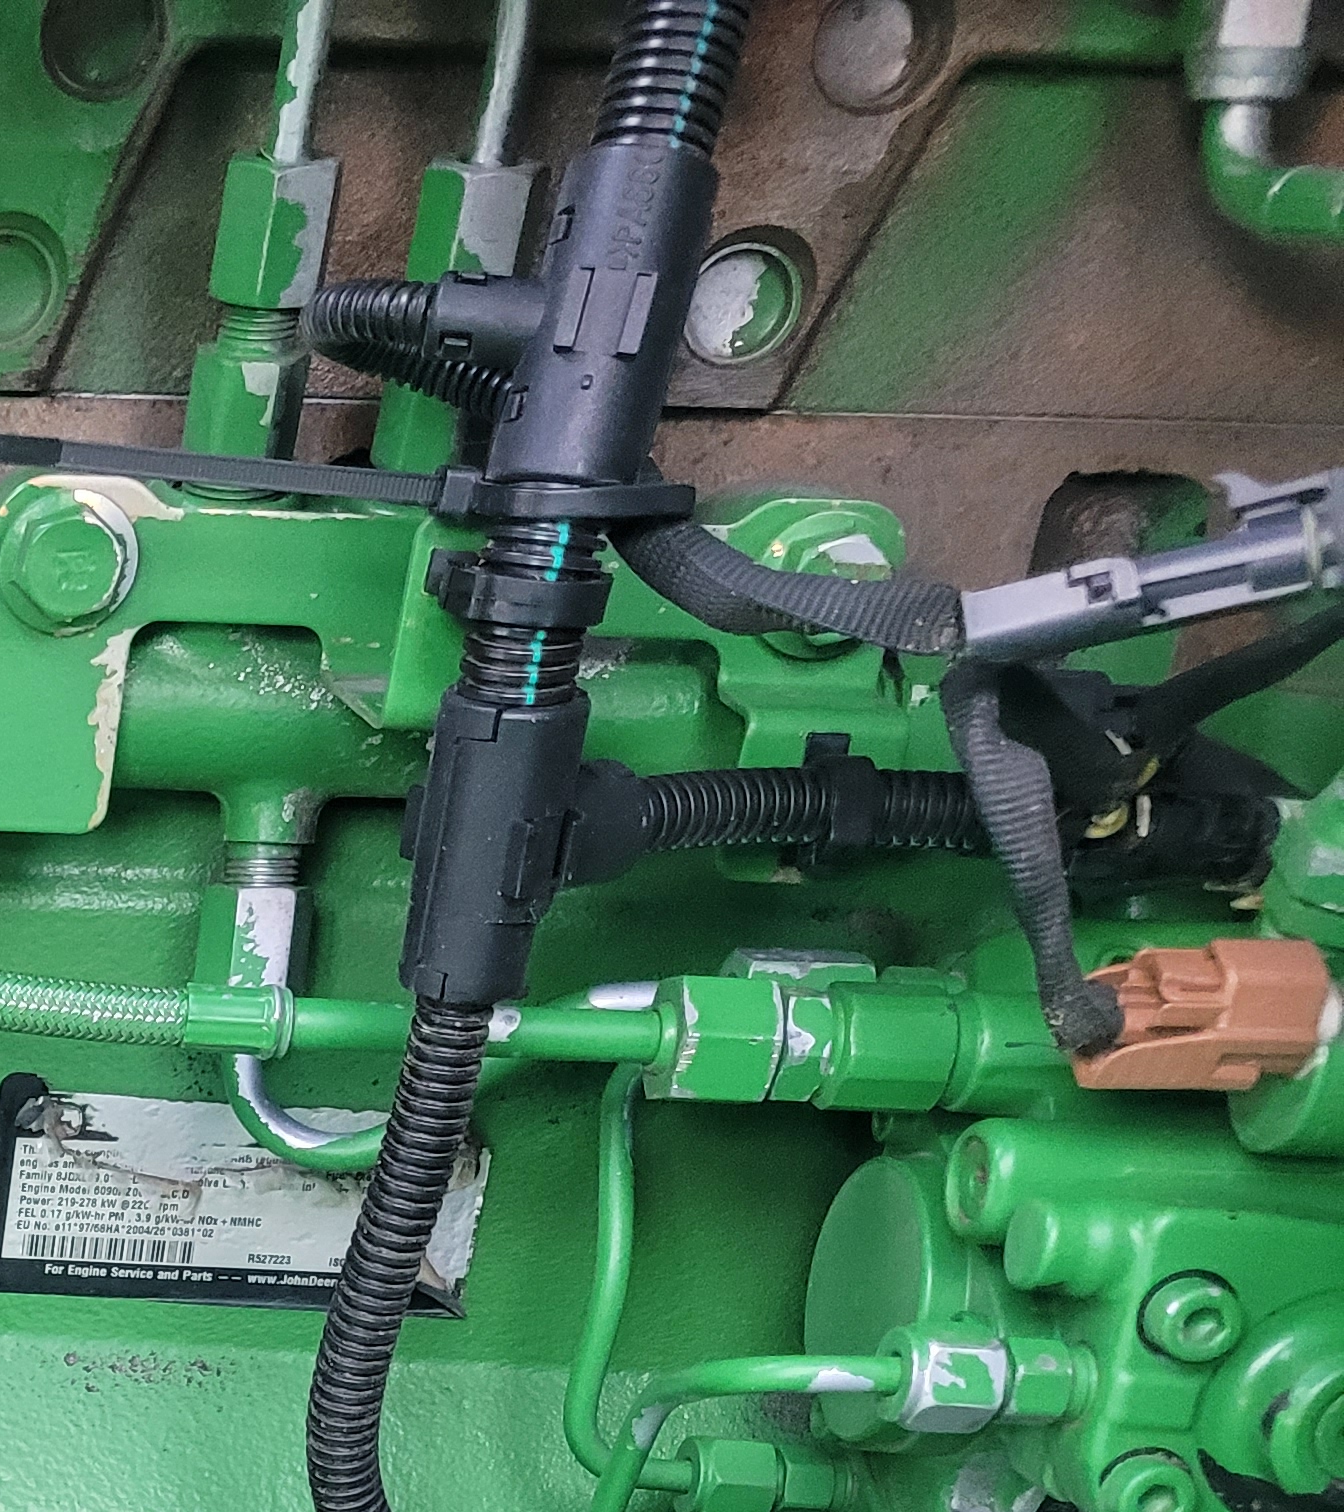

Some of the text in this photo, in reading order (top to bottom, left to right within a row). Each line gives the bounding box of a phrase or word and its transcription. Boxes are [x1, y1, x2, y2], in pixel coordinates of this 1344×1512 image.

[19, 1170, 53, 1182] Family
[21, 1183, 55, 1195] Engine
[59, 1184, 90, 1194] Model
[57, 1197, 97, 1208] 219-278
[100, 1198, 116, 1208] kW
[159, 1203, 178, 1213] rpm
[18, 1208, 36, 1218] FEL
[40, 1209, 62, 1219] 0.17
[65, 1210, 105, 1222] g/kW-hr
[108, 1212, 124, 1222] PM
[134, 1213, 151, 1223] 3.9
[198, 1215, 219, 1226] NOx
[230, 1216, 262, 1228] NMHC
[16, 1220, 30, 1230] EU
[247, 1253, 291, 1265] R527223
[44, 1264, 65, 1275] For
[68, 1265, 107, 1278] Engine
[111, 1267, 154, 1279] Service
[157, 1270, 179, 1281] and
[183, 1270, 214, 1282] Parts
[247, 1274, 338, 1287] www.JohnDeer
